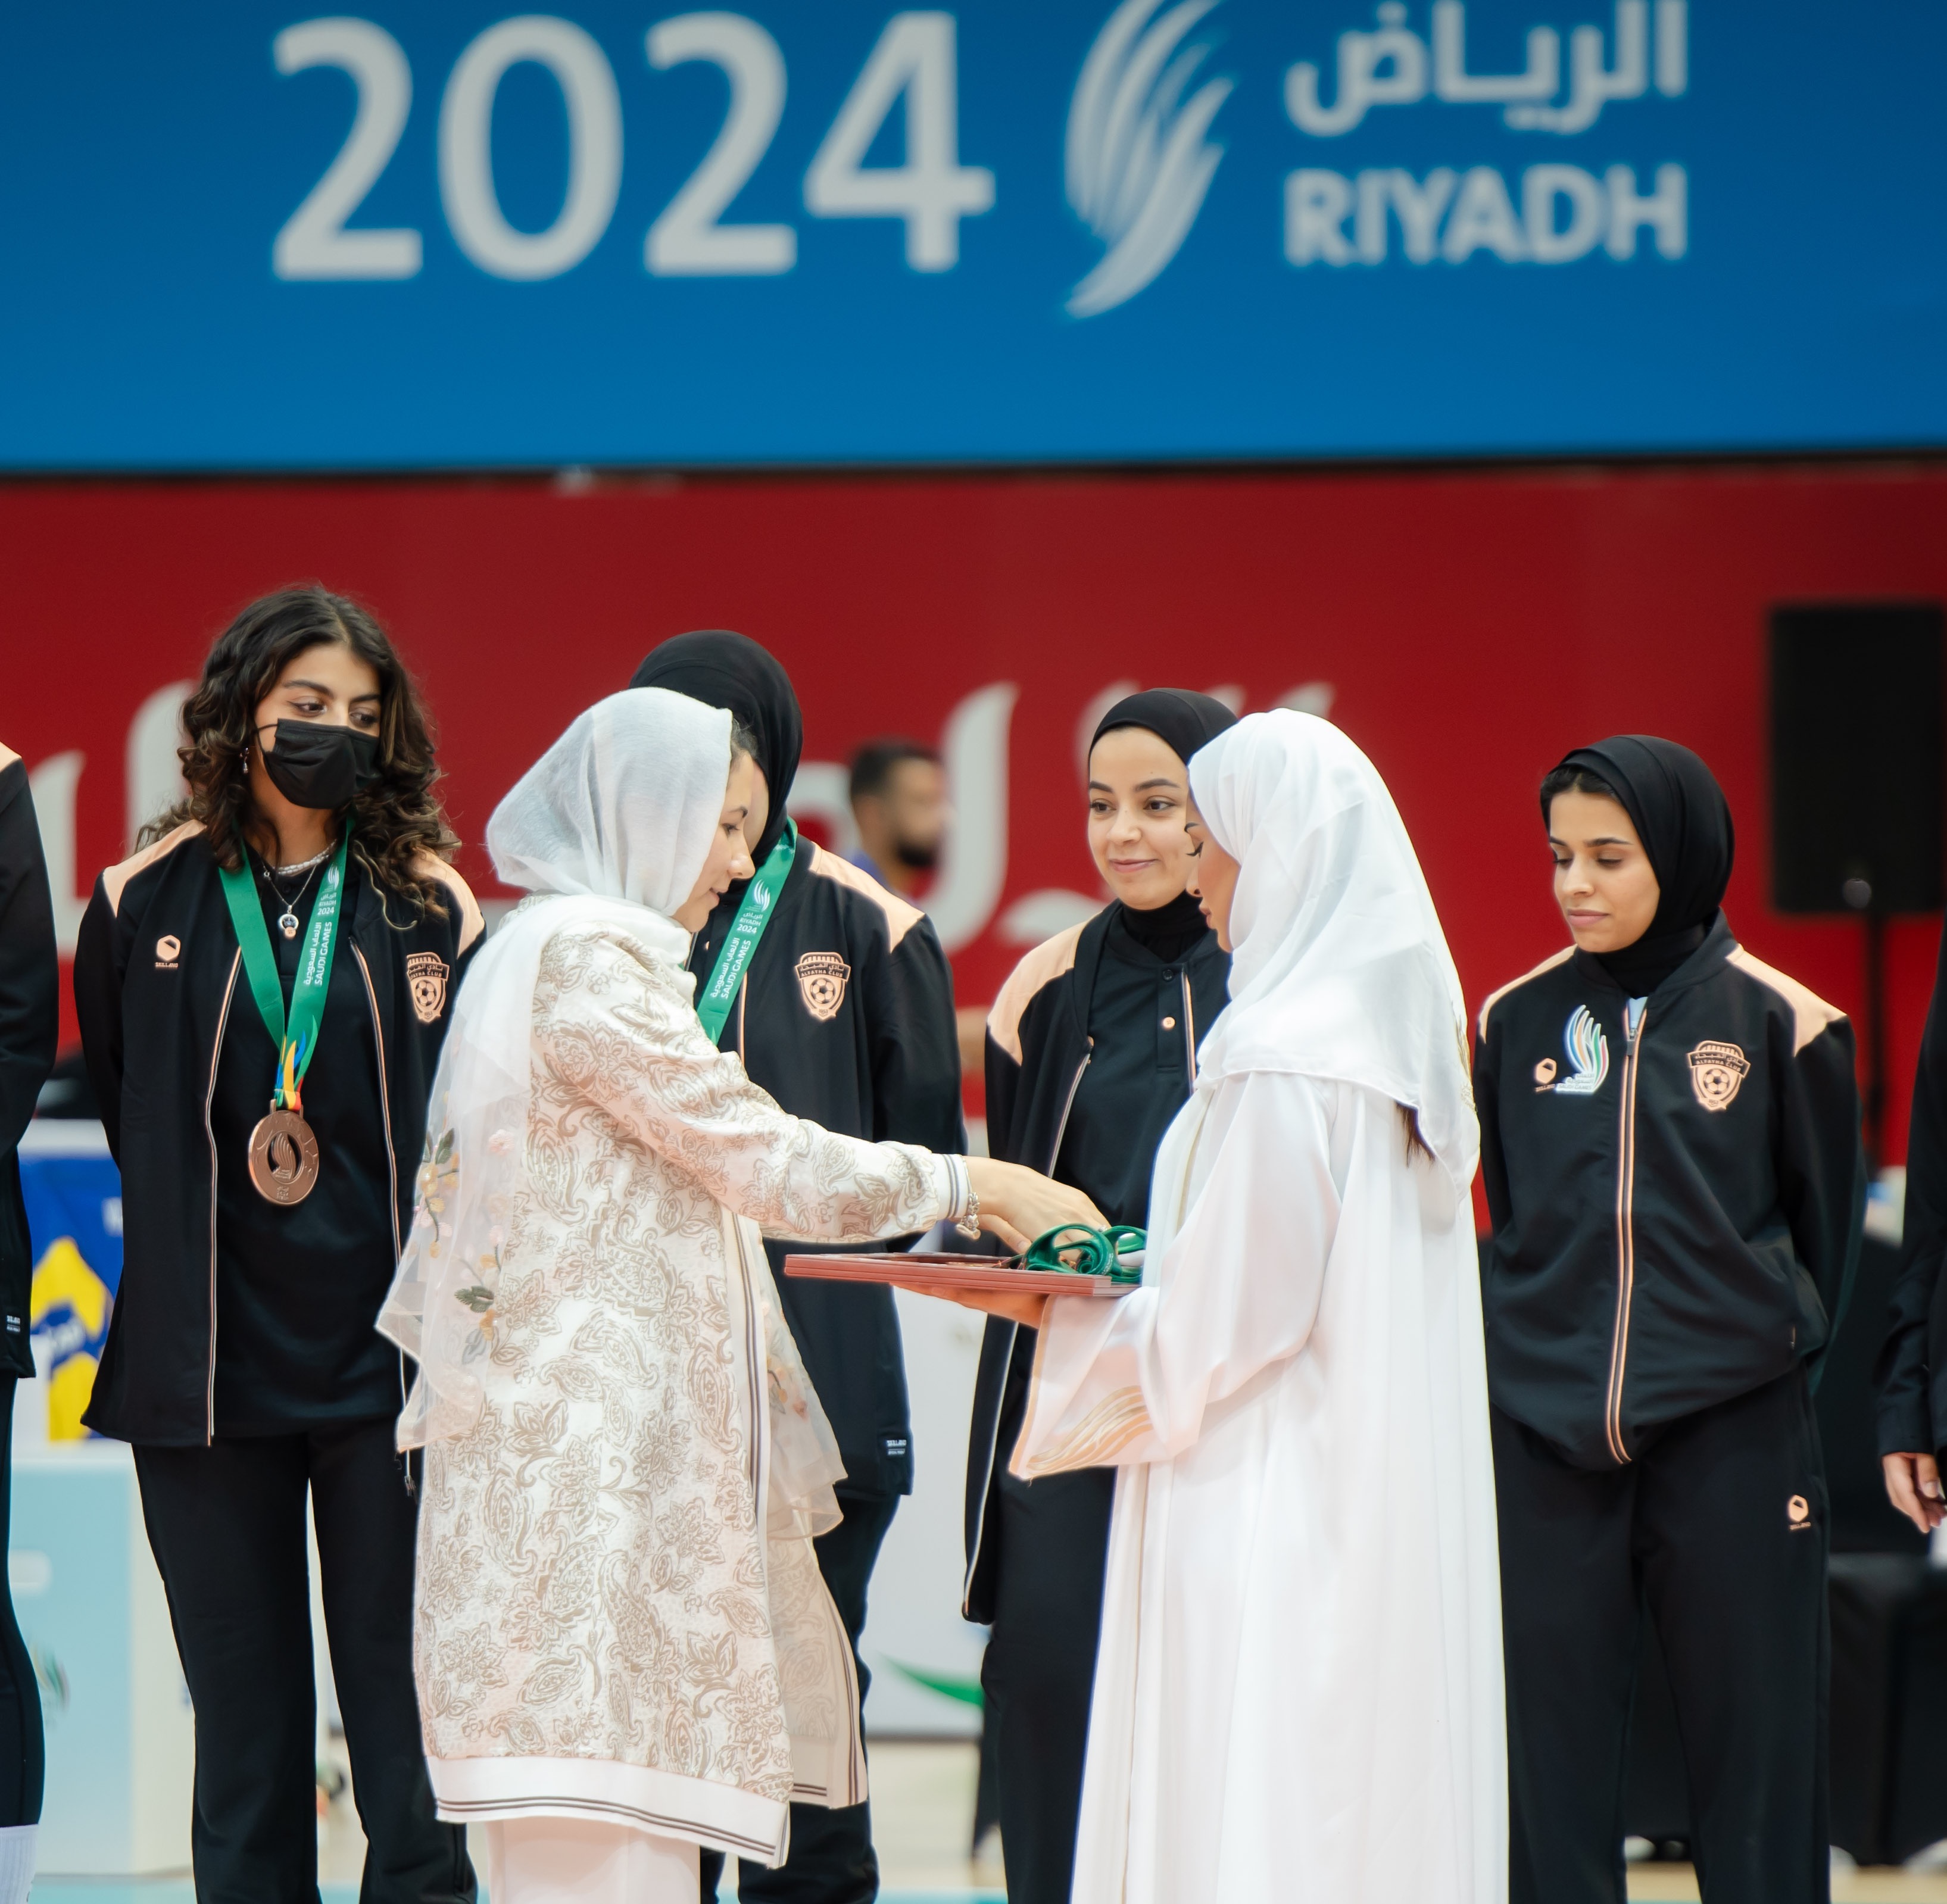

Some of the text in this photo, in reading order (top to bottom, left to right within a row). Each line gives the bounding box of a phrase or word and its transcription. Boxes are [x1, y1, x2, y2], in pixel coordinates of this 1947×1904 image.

[273, 10, 996, 282] 2024
[1283, 163, 1687, 266] RIYADH
[317, 907, 335, 915] 2024
[737, 924, 757, 934] 2024
[740, 917, 762, 926] RIYADH
[304, 948, 317, 985] السعودية
[314, 922, 332, 986] SAUDI GAMES
[720, 939, 751, 1000] SAUDI GAMES
[710, 962, 730, 998] السعودية
[1726, 1062, 1741, 1072] CLUB
